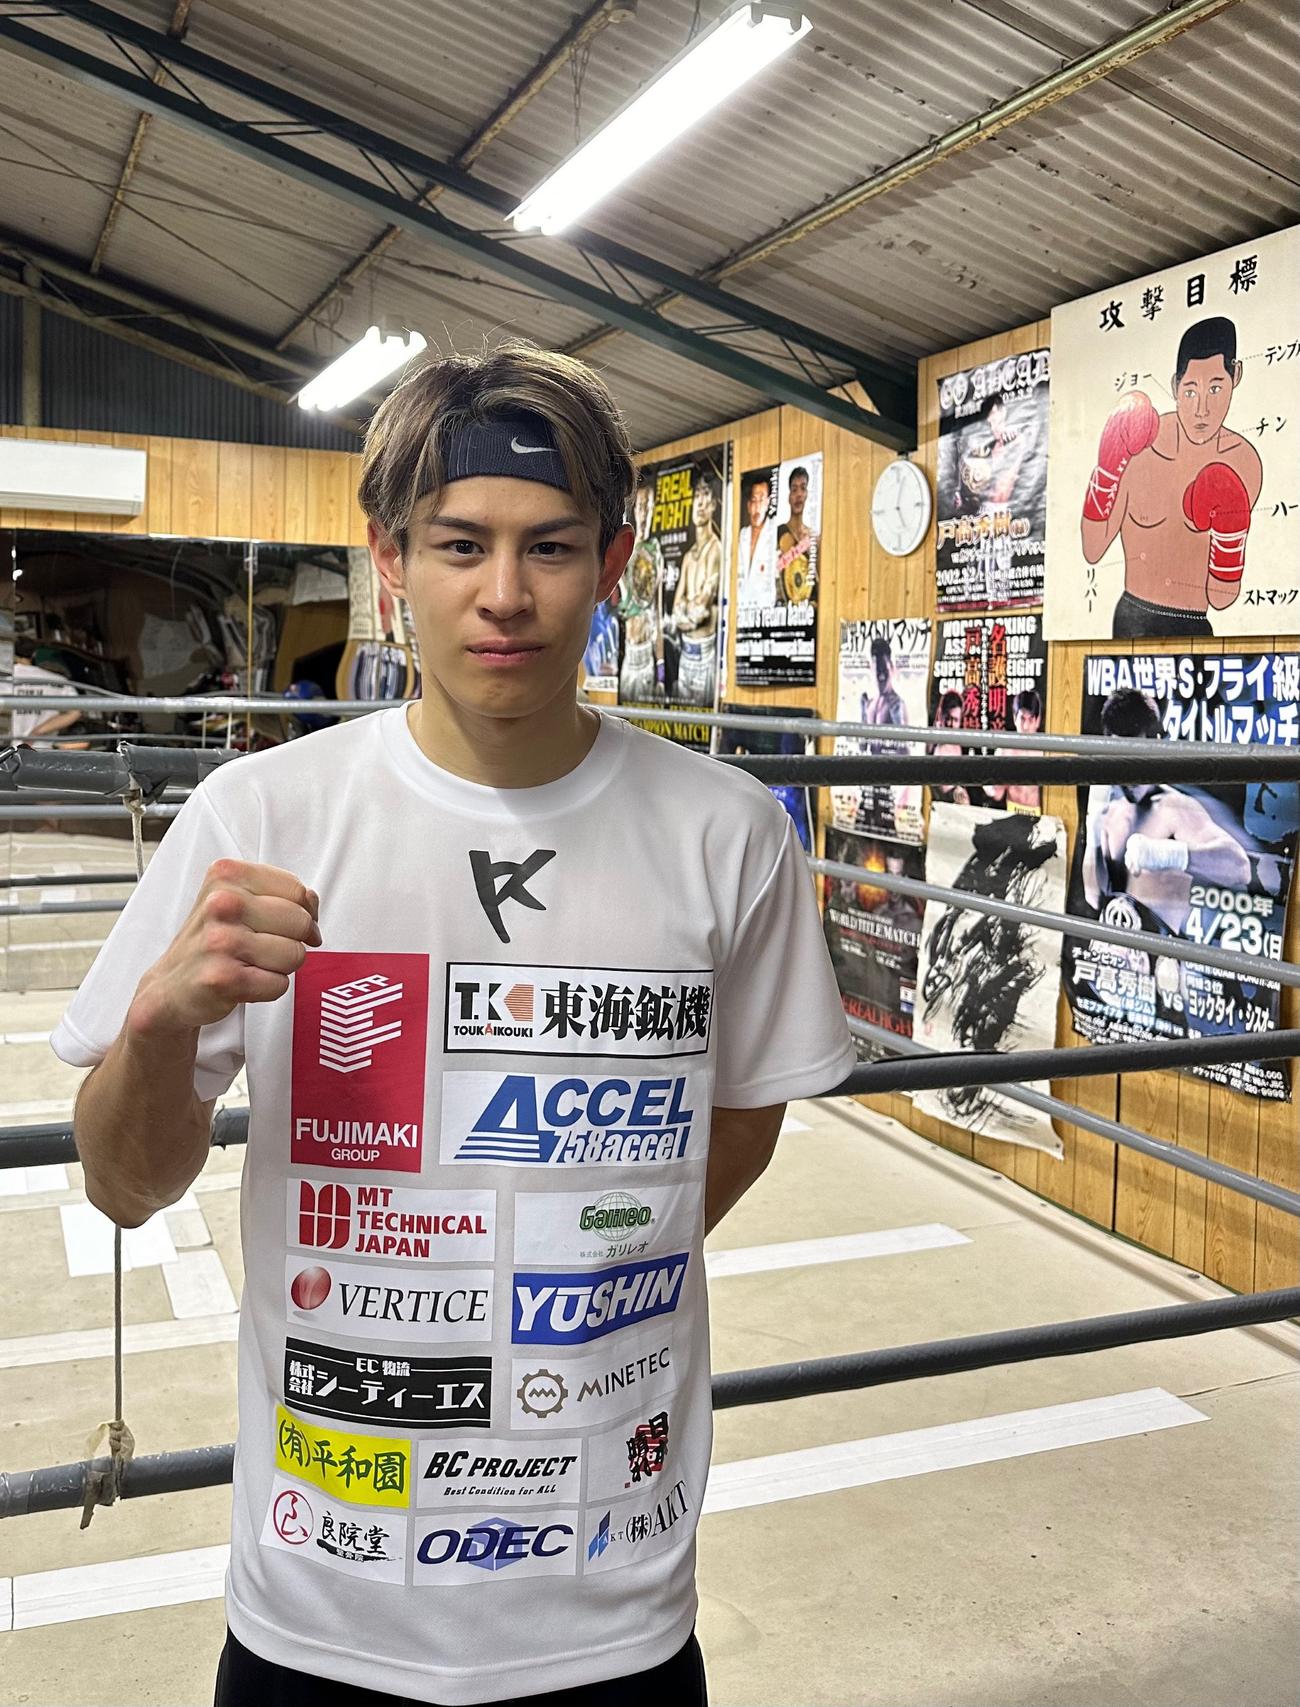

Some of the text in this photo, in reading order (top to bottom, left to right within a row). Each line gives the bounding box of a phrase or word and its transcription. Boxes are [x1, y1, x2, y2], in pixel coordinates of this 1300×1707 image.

[1099, 254, 1258, 332] 攻撃目標
[1114, 371, 1152, 391] ジョー
[1256, 415, 1286, 436] チン
[661, 470, 692, 503] REAL
[652, 498, 693, 533] FIGHT
[1271, 500, 1300, 518] ハー
[1086, 568, 1098, 613] リバー
[1243, 588, 1299, 605] ストマック
[934, 660, 967, 678] SUPE
[1163, 700, 1300, 746] タイトルマッチ
[1190, 886, 1274, 917] 2000年
[1072, 947, 1126, 968] チャンピオン
[540, 980, 710, 1041] 東海鉱機
[1162, 991, 1184, 1012] VS
[454, 1023, 533, 1038] TOUKAIKOUKI
[471, 1075, 694, 1132] ACCEL
[296, 1118, 418, 1148] FUJIMAKI
[549, 1125, 692, 1163] 758accel
[331, 1148, 380, 1162] GROUP
[358, 1187, 392, 1206] MT
[357, 1213, 487, 1235] TECHNICAL
[355, 1235, 430, 1258] JAPAN
[606, 1241, 648, 1258] ガリレオ
[338, 1282, 489, 1323] VERTICE
[290, 1360, 315, 1380] 株式
[356, 1358, 410, 1376] EC 物流
[577, 1347, 670, 1402] MINETEC
[316, 1371, 485, 1410] シーティーエス
[424, 1451, 578, 1478] BC PROJECT
[444, 1484, 556, 1496] Best Condition for ALL
[320, 1511, 390, 1555] 良院堂
[417, 1525, 574, 1566] ODEC
